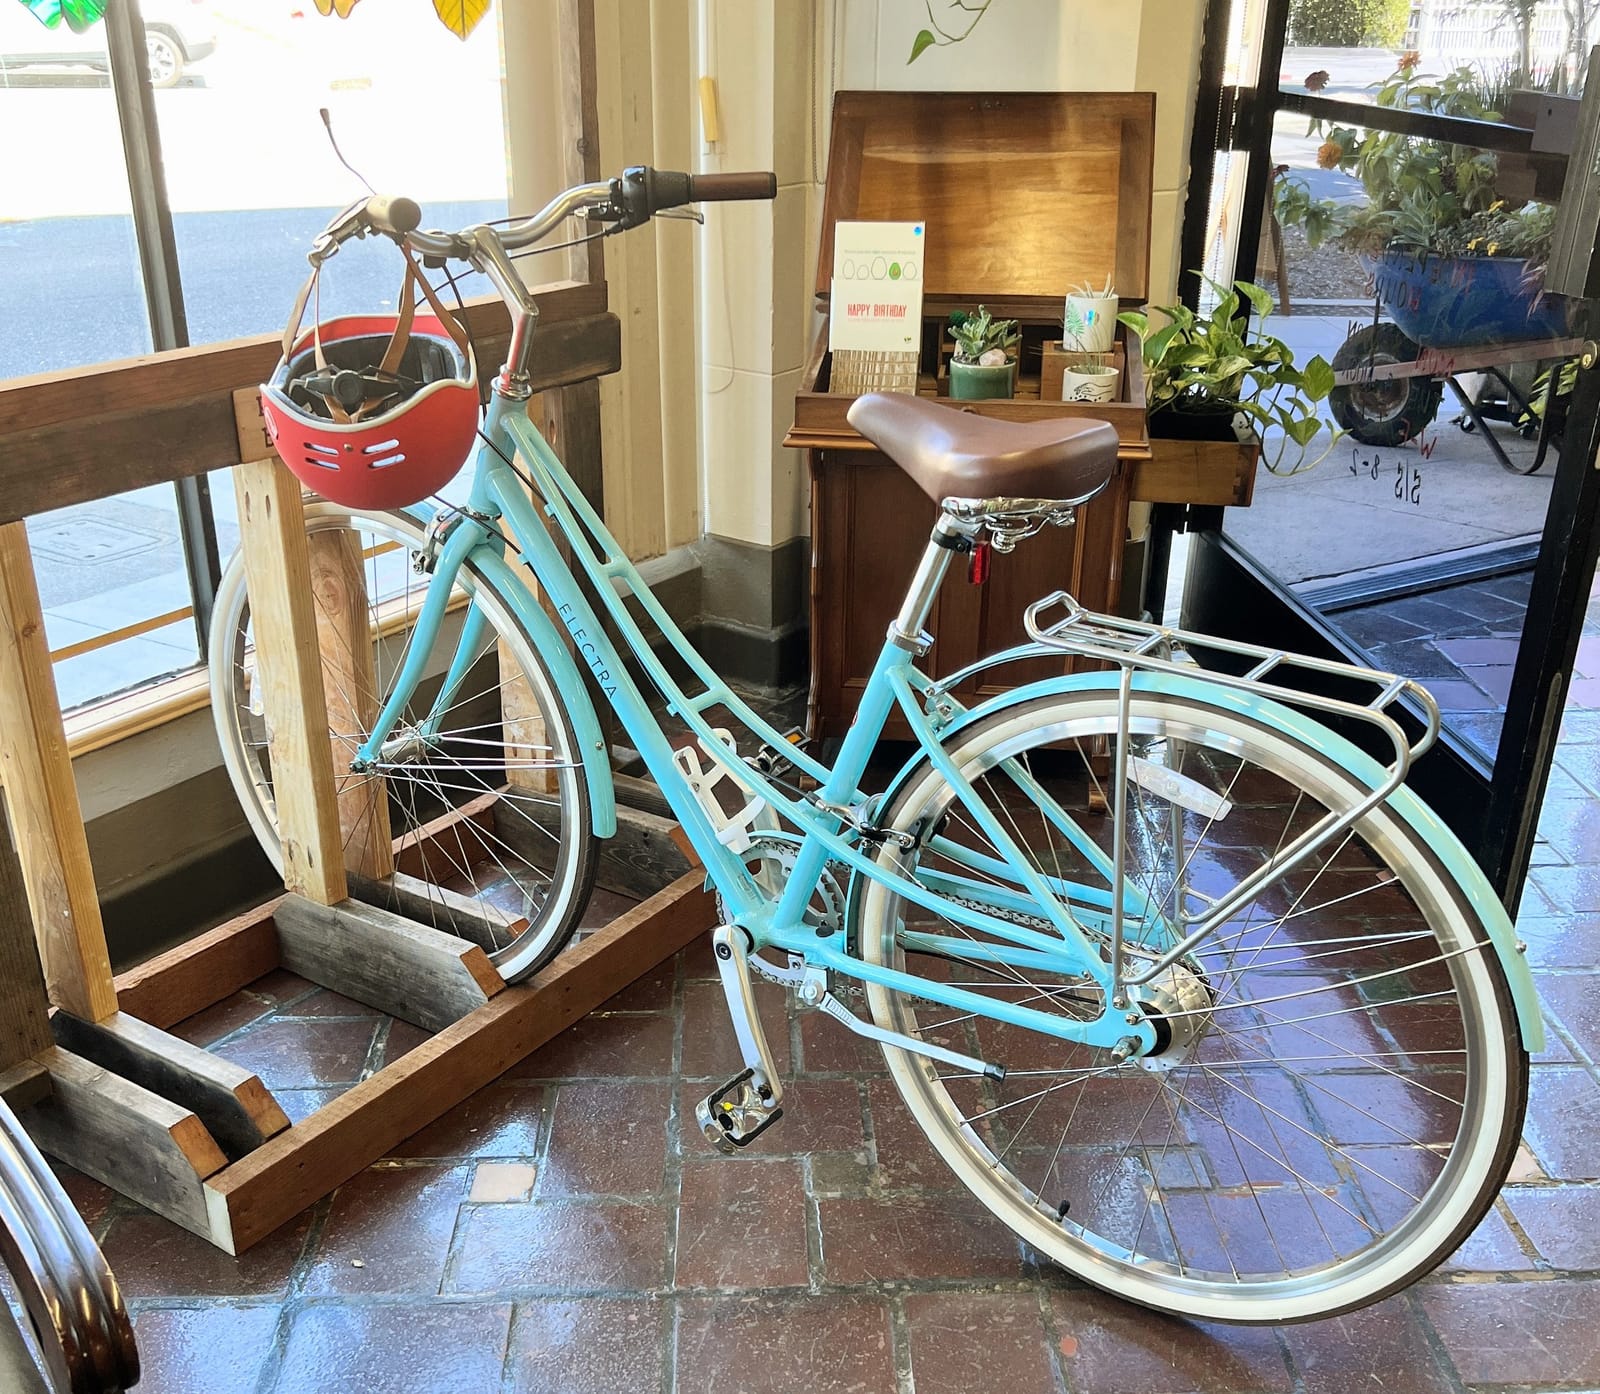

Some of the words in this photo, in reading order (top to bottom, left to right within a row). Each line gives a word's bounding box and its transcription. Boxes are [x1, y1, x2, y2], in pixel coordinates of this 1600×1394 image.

[847, 303, 870, 317] HAPPY
[873, 303, 907, 318] BIRTHDAY
[559, 603, 617, 699] ELECTRA
